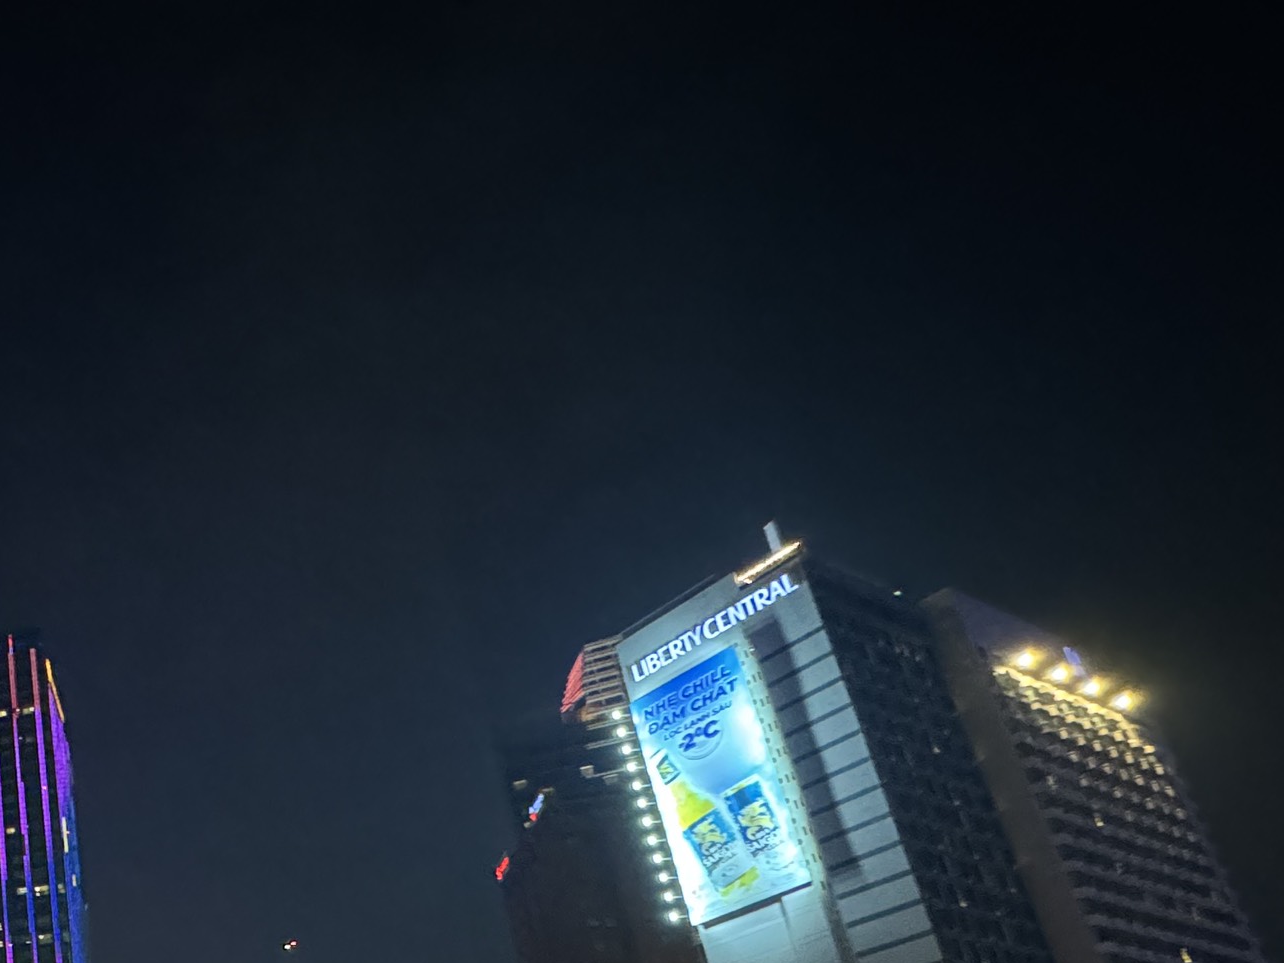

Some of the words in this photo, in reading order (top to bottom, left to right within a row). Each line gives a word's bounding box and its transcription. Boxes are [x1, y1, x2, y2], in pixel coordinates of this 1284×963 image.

[630, 625, 702, 682] LIBERTY
[702, 573, 799, 639] CENTRAL
[680, 665, 731, 698] CHILL
